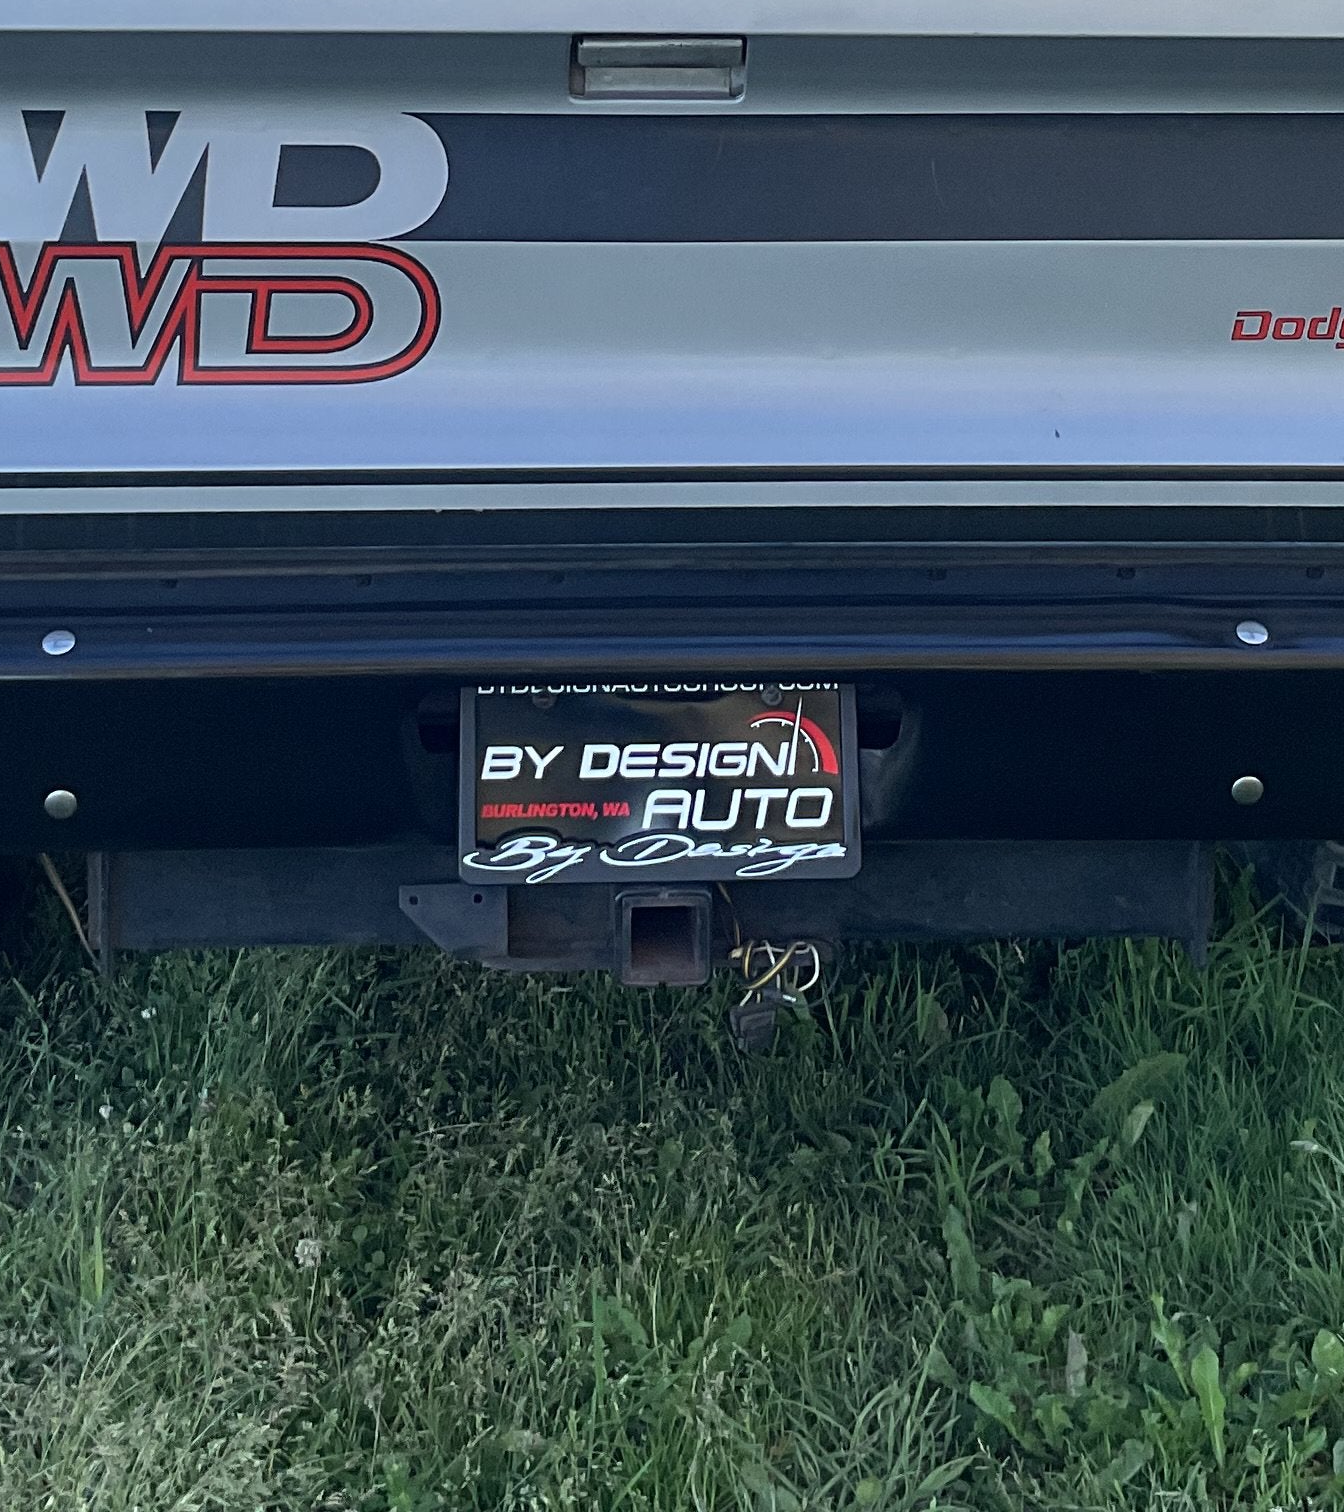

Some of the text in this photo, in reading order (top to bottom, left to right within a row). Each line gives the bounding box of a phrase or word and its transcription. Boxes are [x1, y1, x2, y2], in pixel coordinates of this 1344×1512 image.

[481, 742, 795, 780] BY DESIGN
[481, 801, 631, 820] BURLINGTON, WA
[641, 787, 833, 830] AUTO
[462, 834, 847, 884] By Design
